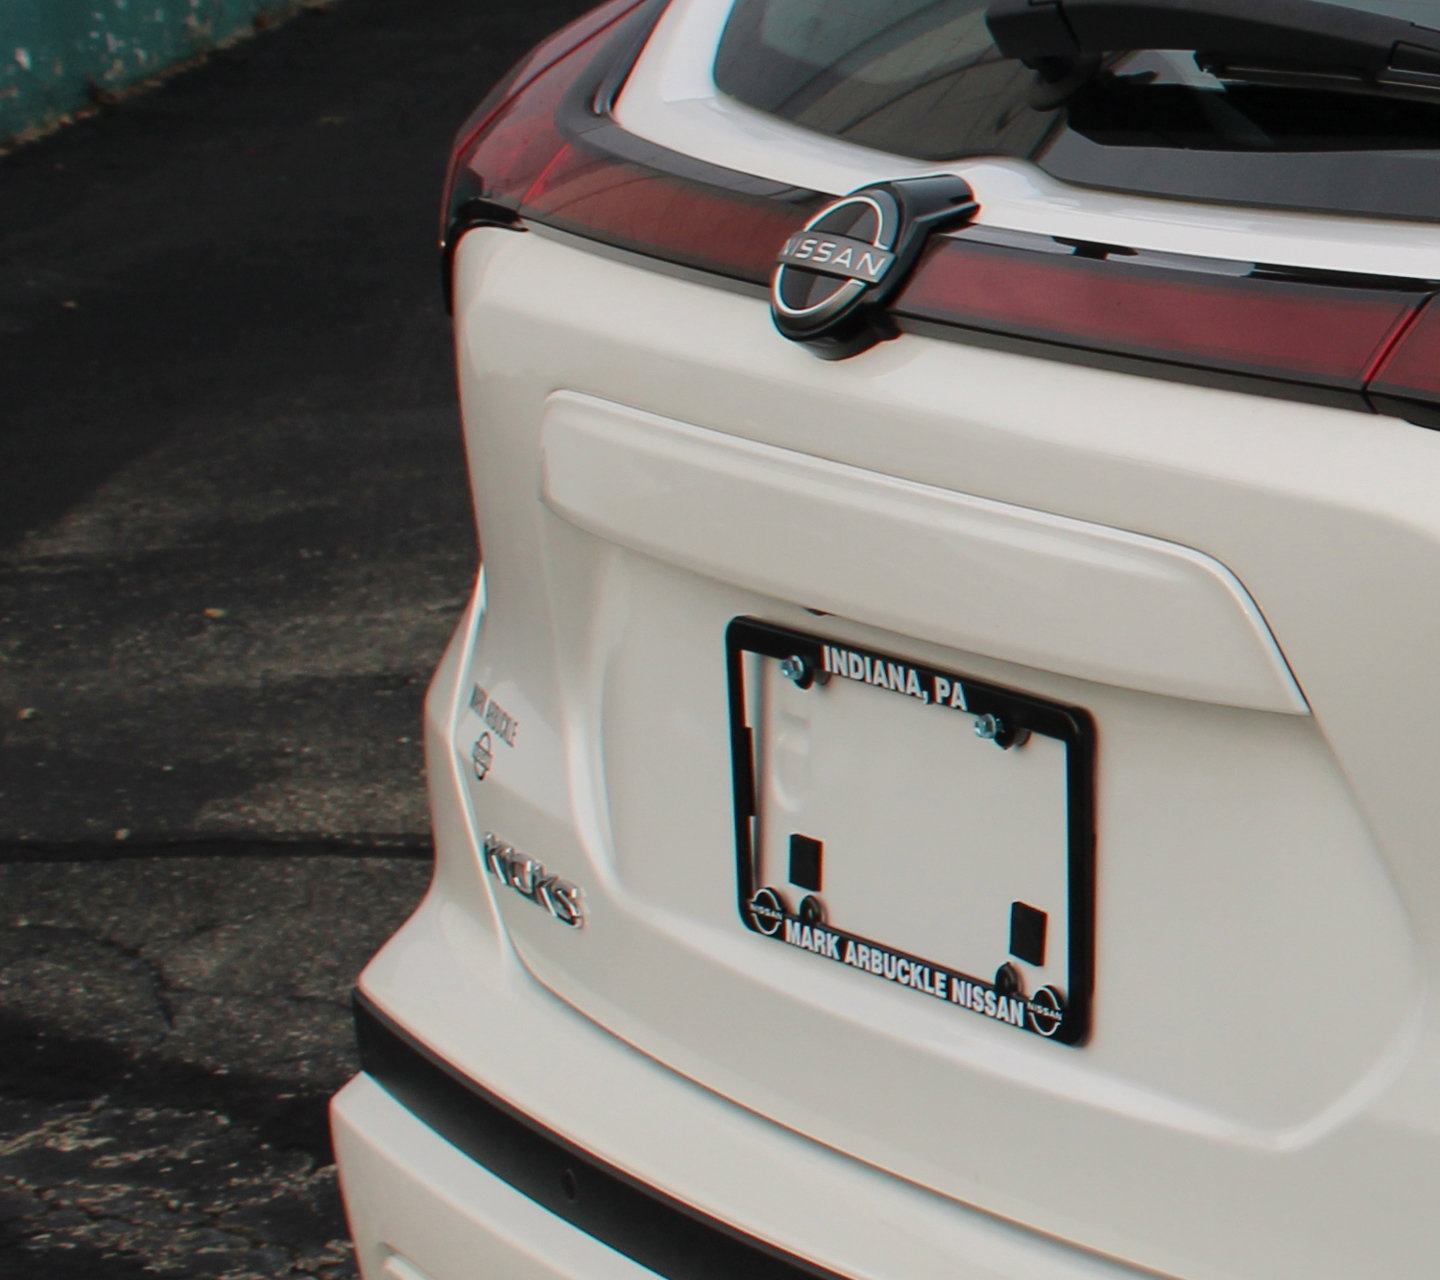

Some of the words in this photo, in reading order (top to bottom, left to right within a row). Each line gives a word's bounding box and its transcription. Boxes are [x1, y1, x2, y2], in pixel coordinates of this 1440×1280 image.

[784, 236, 887, 277] NISSAN
[823, 645, 929, 704] INDIANA,
[934, 676, 967, 711] PA
[785, 918, 841, 961] MARK
[844, 940, 948, 999] ARBUCKLE
[951, 977, 1025, 1028] NISSAN
[1026, 1001, 1063, 1021] NISSAN
